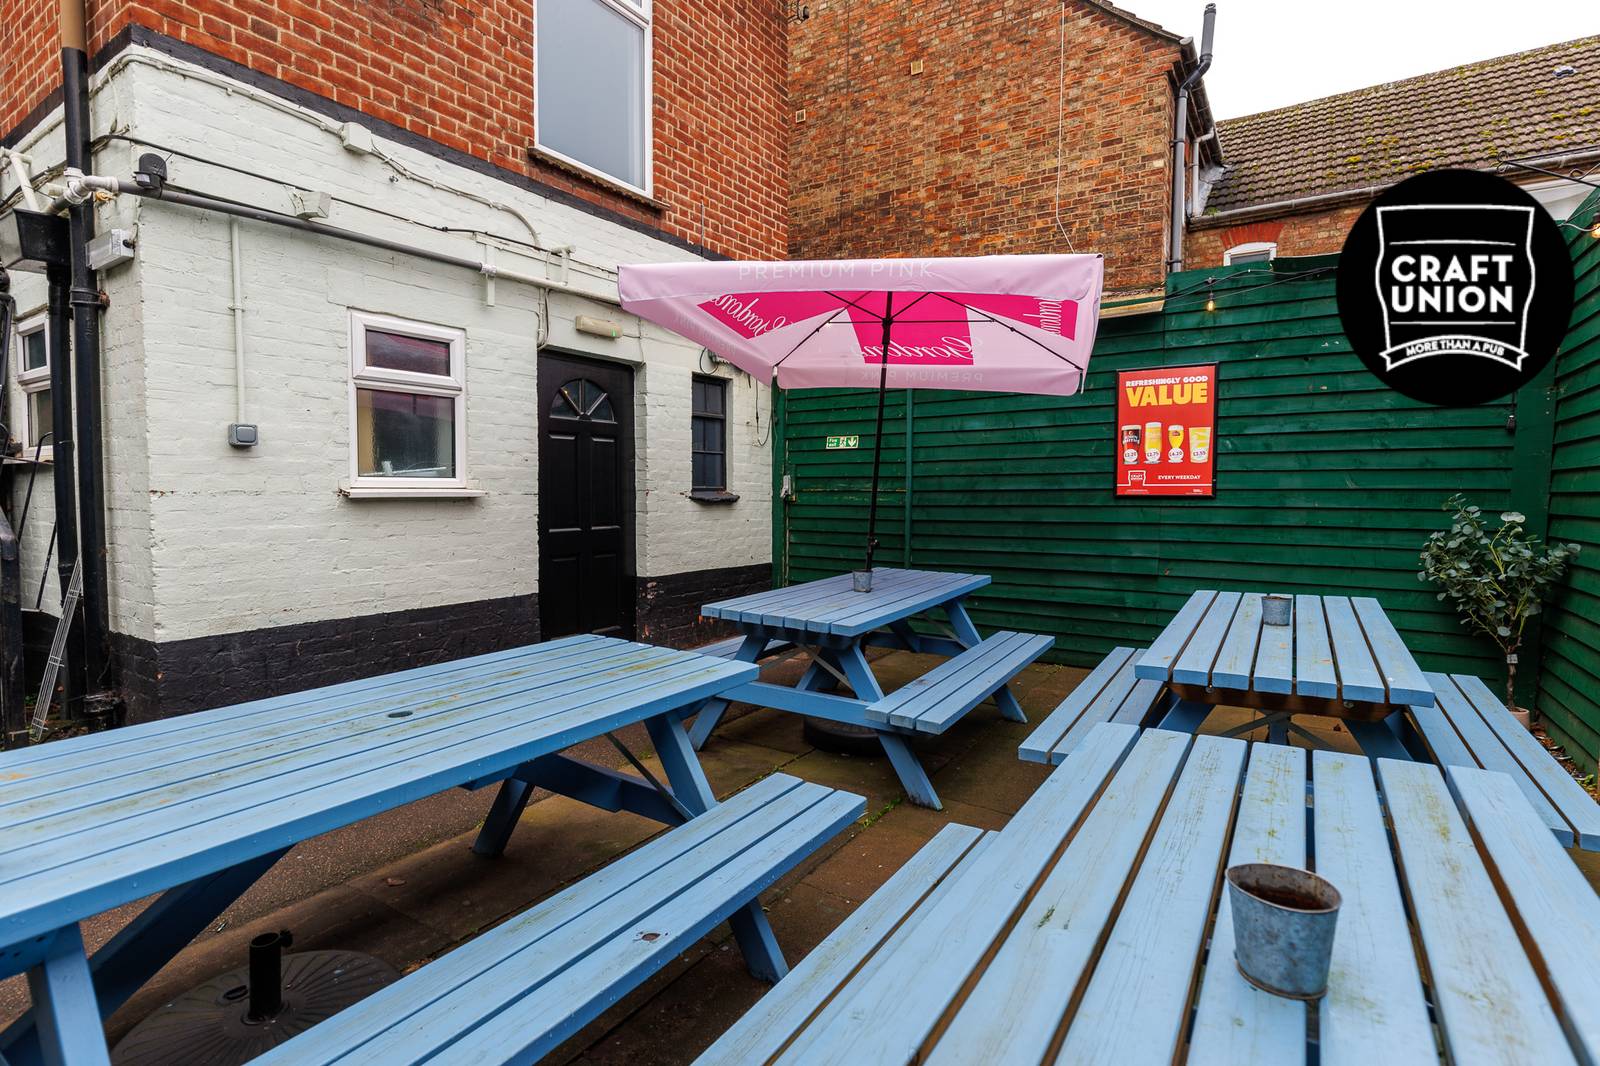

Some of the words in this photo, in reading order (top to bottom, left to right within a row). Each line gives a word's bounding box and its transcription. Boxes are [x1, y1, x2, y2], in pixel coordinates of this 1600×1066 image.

[738, 262, 855, 280] PREMIUM
[871, 261, 934, 279] PINK
[1126, 377, 1181, 387] REFRESHINGLY
[1183, 375, 1208, 383] GOOD
[1125, 383, 1208, 407] VALUE
